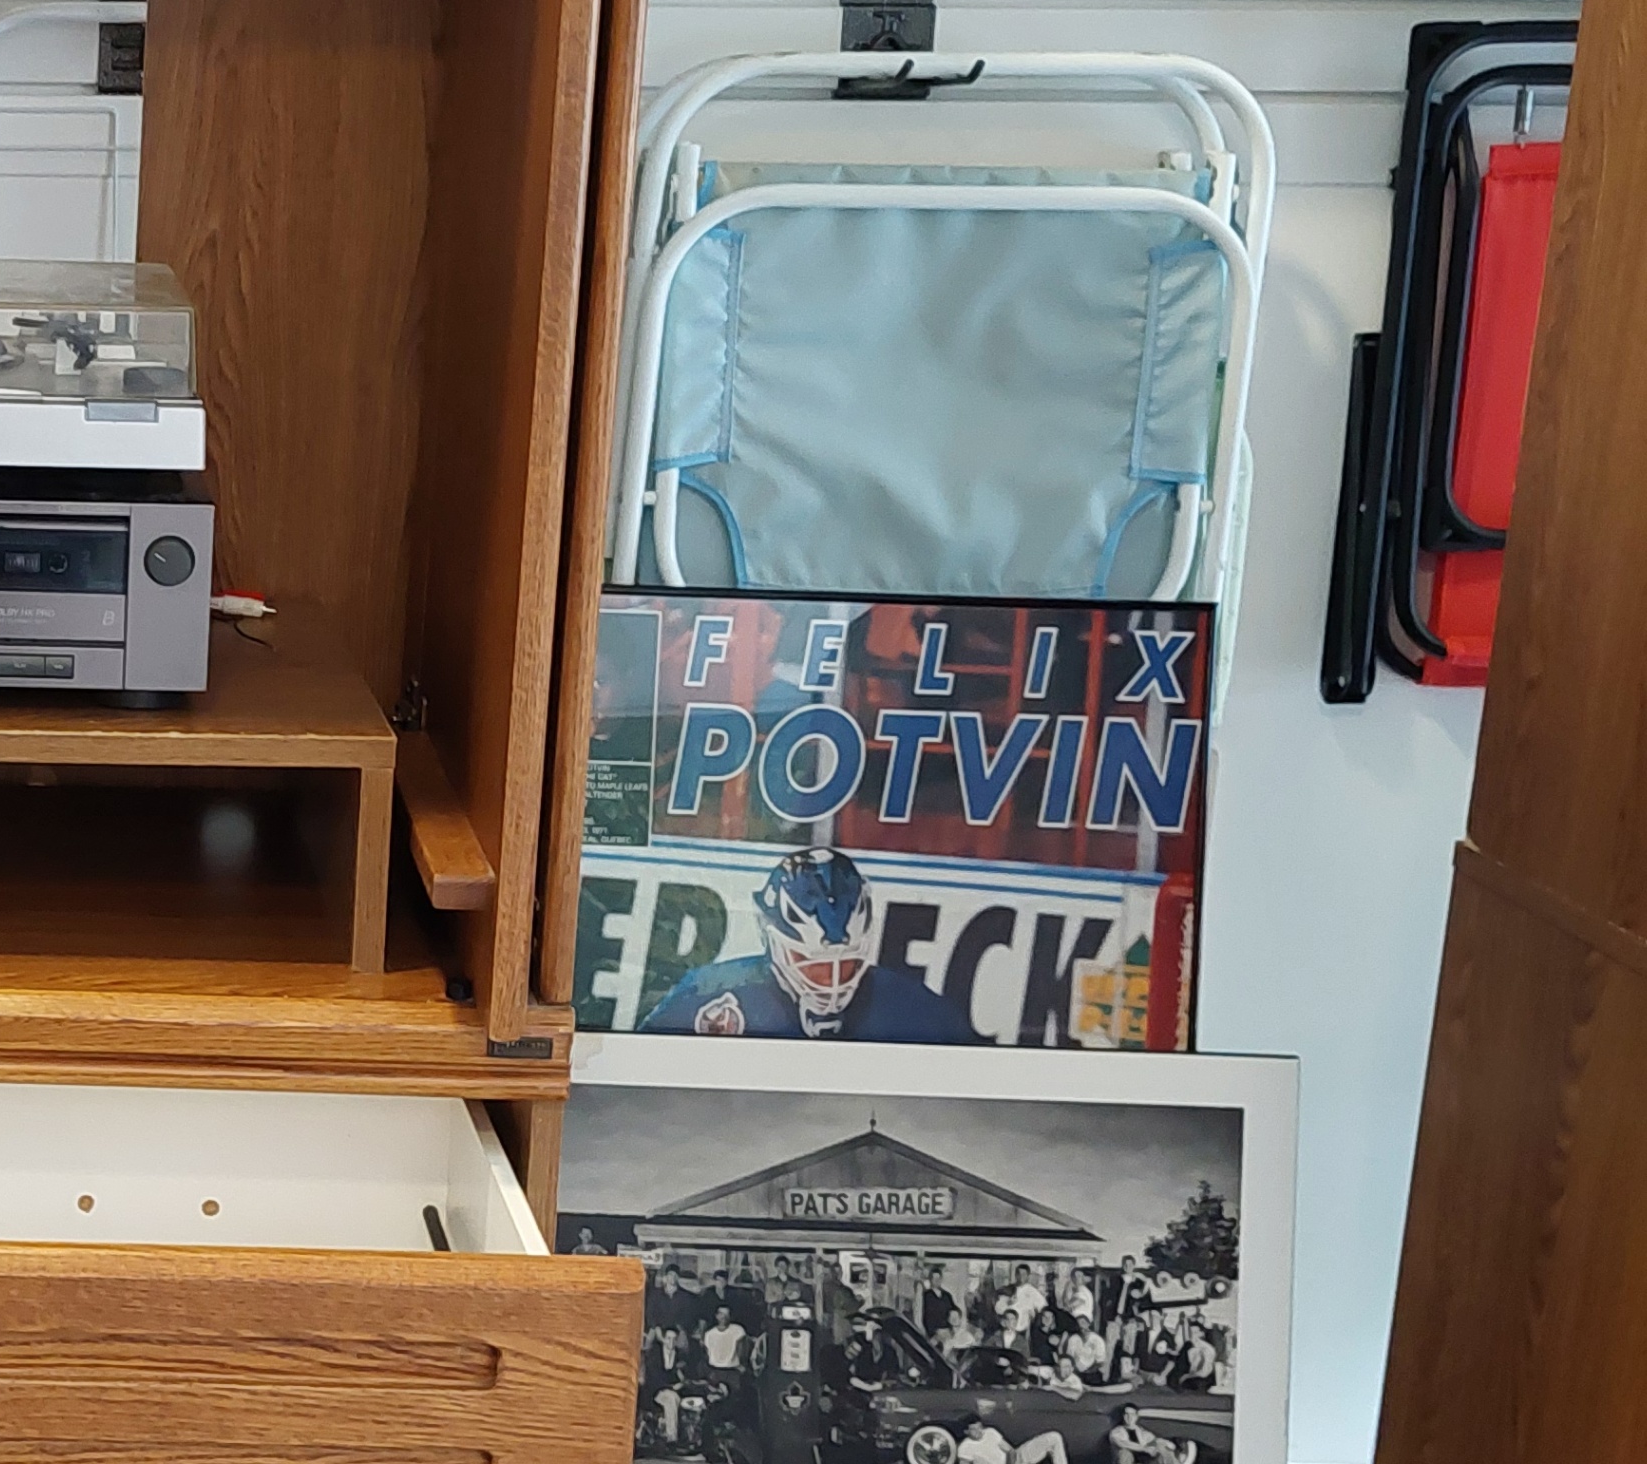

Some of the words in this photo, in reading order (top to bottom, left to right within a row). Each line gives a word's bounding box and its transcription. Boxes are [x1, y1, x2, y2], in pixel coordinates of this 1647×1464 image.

[683, 614, 1195, 705] FELIX
[597, 782, 623, 791] MAPLE
[624, 783, 648, 792] LEAFS
[666, 702, 1204, 834] POTVIN
[857, 1191, 945, 1216] GARAGE
